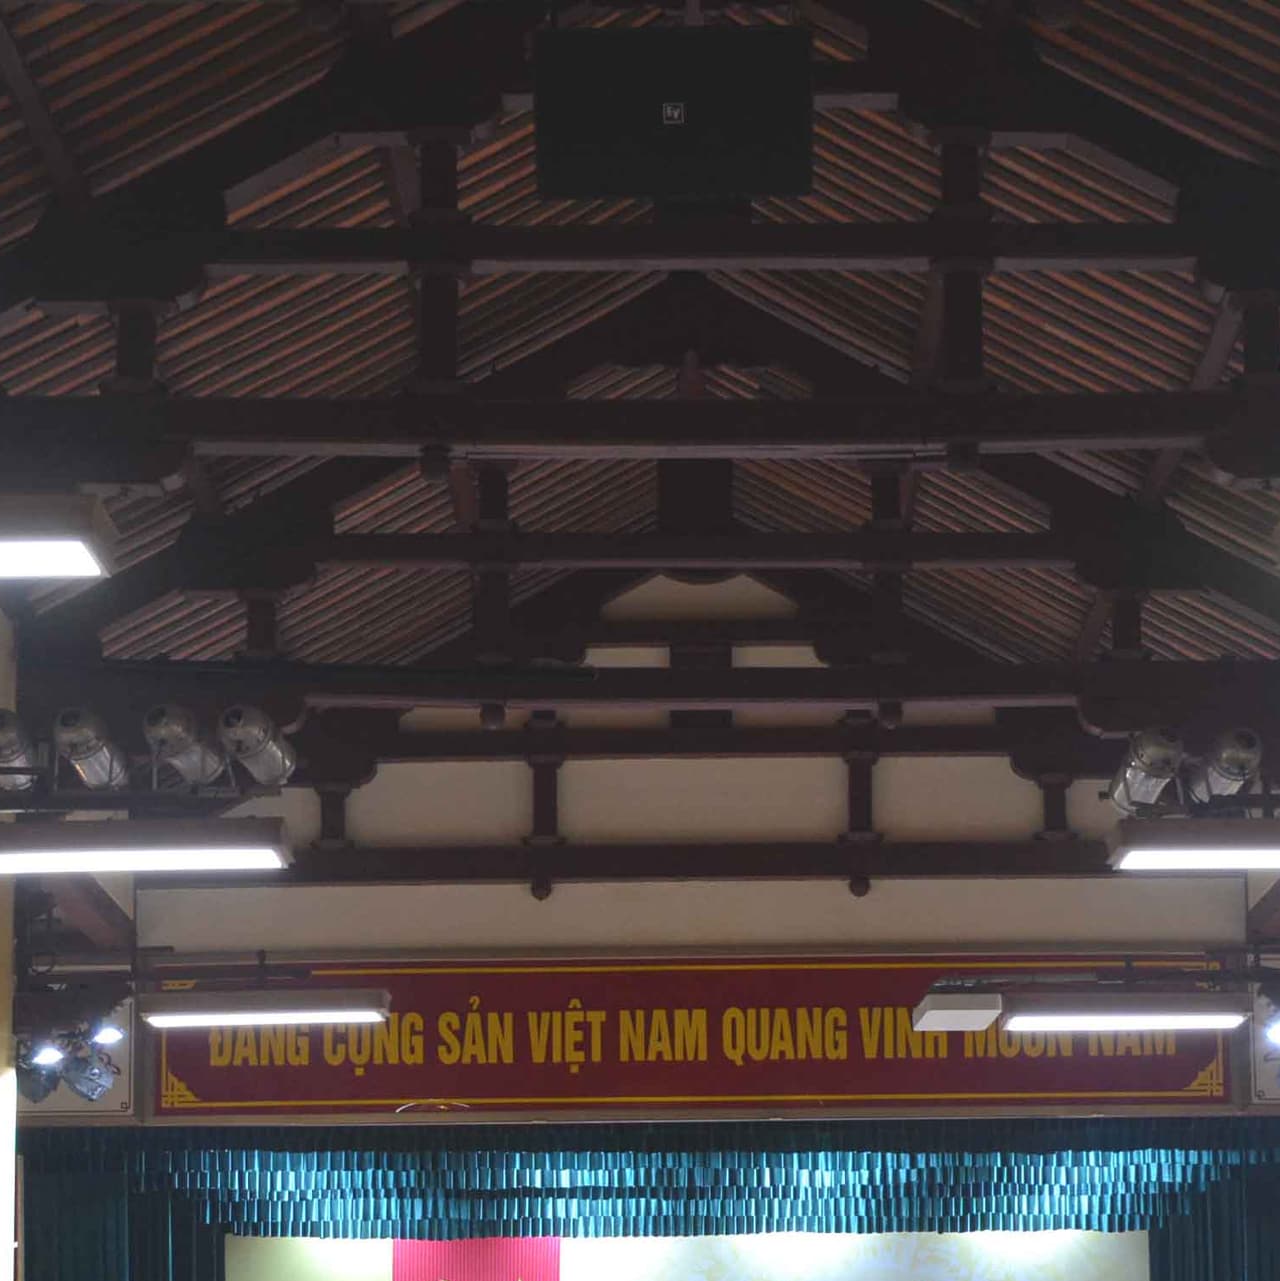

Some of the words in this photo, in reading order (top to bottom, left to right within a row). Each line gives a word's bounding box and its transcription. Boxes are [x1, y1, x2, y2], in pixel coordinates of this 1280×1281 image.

[438, 996, 514, 1065] SẢN
[527, 999, 606, 1073] VIỆT
[619, 1008, 708, 1062] NAM
[722, 1006, 848, 1066] QUANG
[859, 1007, 948, 1059] VINH
